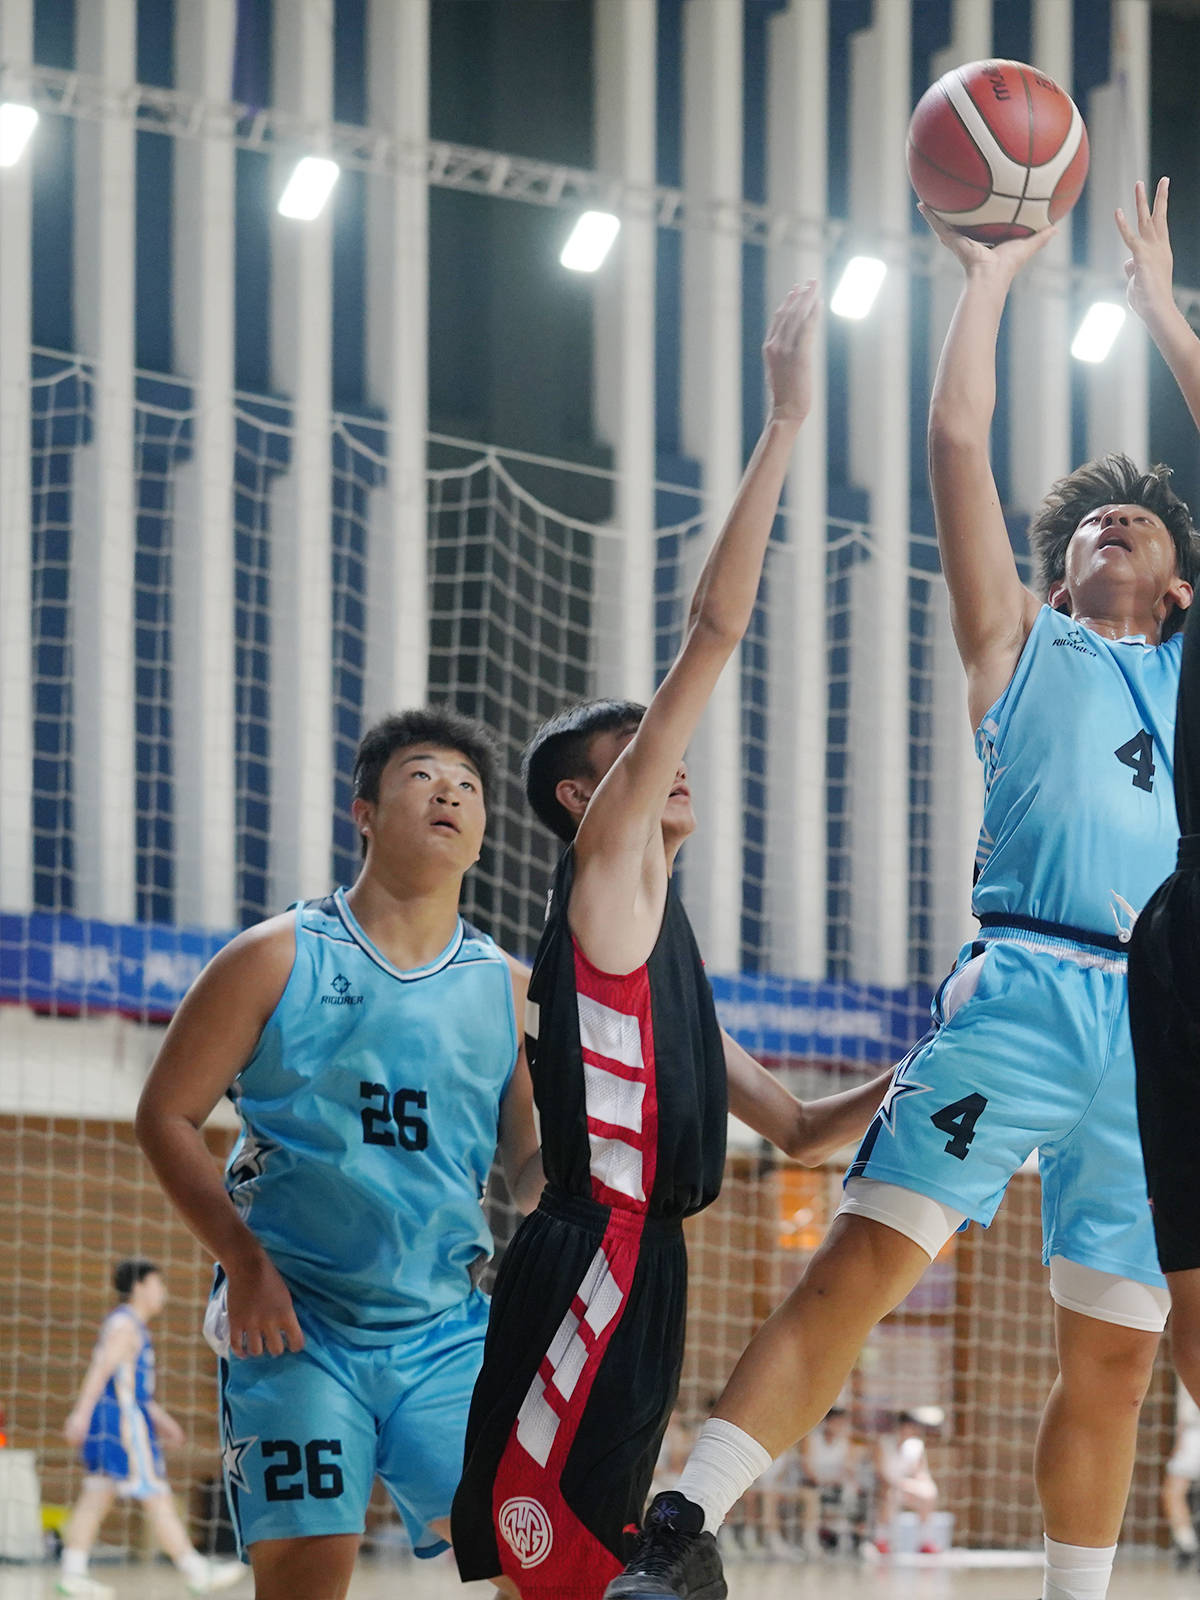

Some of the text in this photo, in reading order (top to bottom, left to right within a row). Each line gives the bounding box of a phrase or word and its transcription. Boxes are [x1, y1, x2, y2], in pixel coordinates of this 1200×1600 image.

[1114, 728, 1155, 793] 4
[320, 995, 364, 1006] RIGORER
[360, 1080, 428, 1151] 26
[930, 1092, 989, 1161] 4
[261, 1439, 344, 1502] 26
